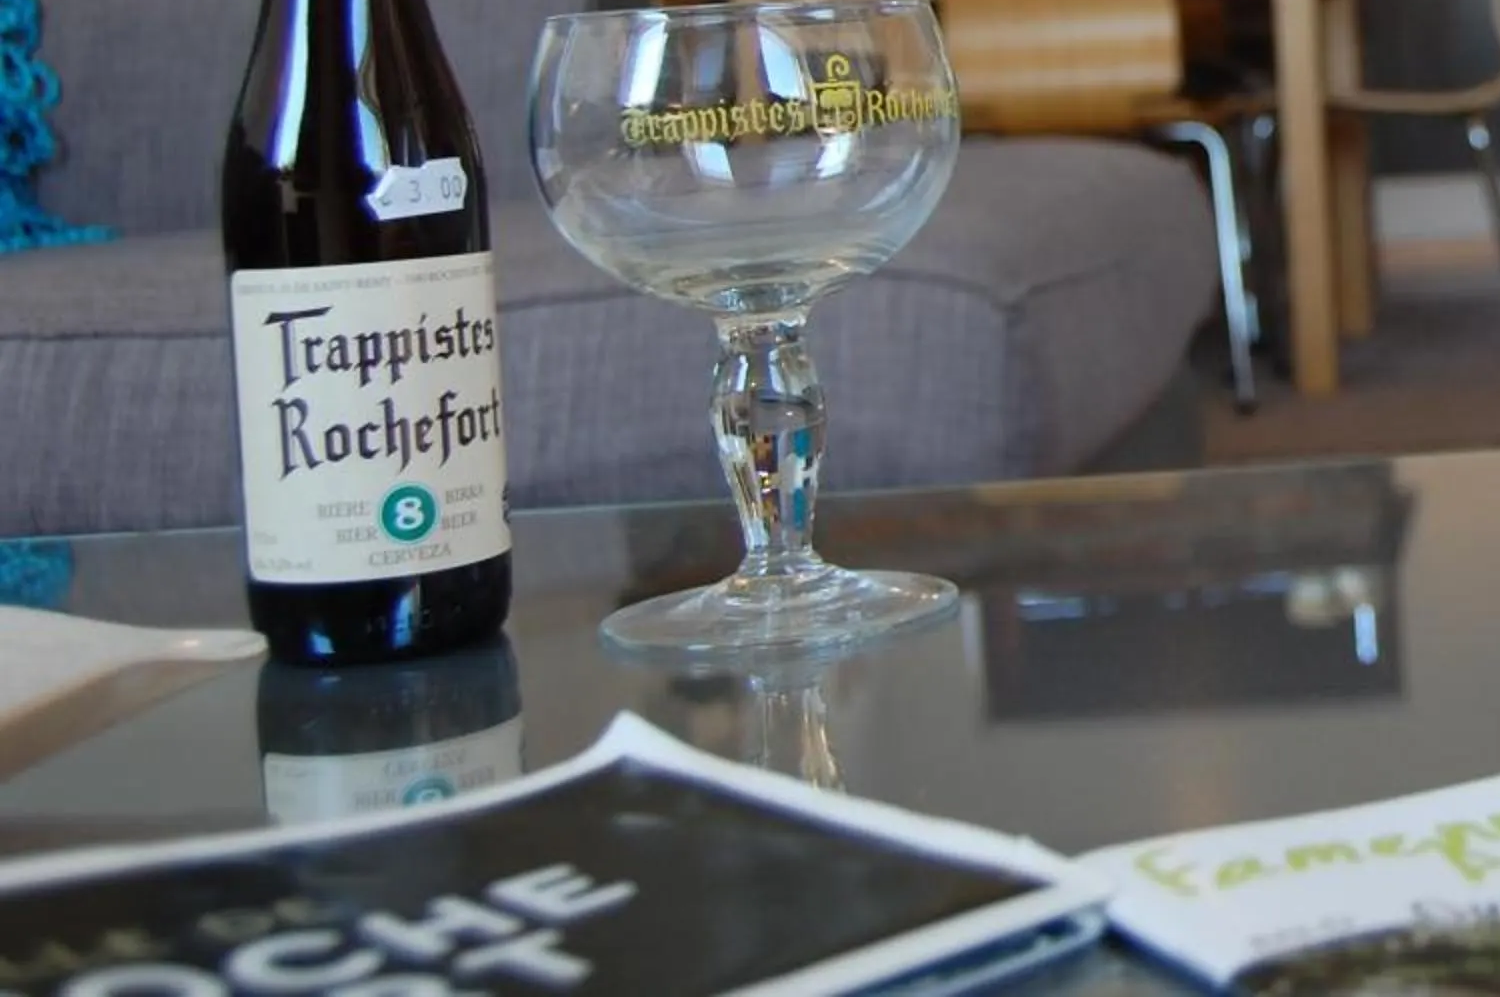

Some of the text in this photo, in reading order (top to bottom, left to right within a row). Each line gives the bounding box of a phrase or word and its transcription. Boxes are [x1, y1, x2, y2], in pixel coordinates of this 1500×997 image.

[620, 98, 806, 146] Trappistes
[261, 304, 495, 391] Trappistes
[270, 387, 501, 481] Rochefort
[394, 495, 425, 530] 8
[367, 542, 453, 567] CERVEZA
[0, 861, 640, 997] OCHE
